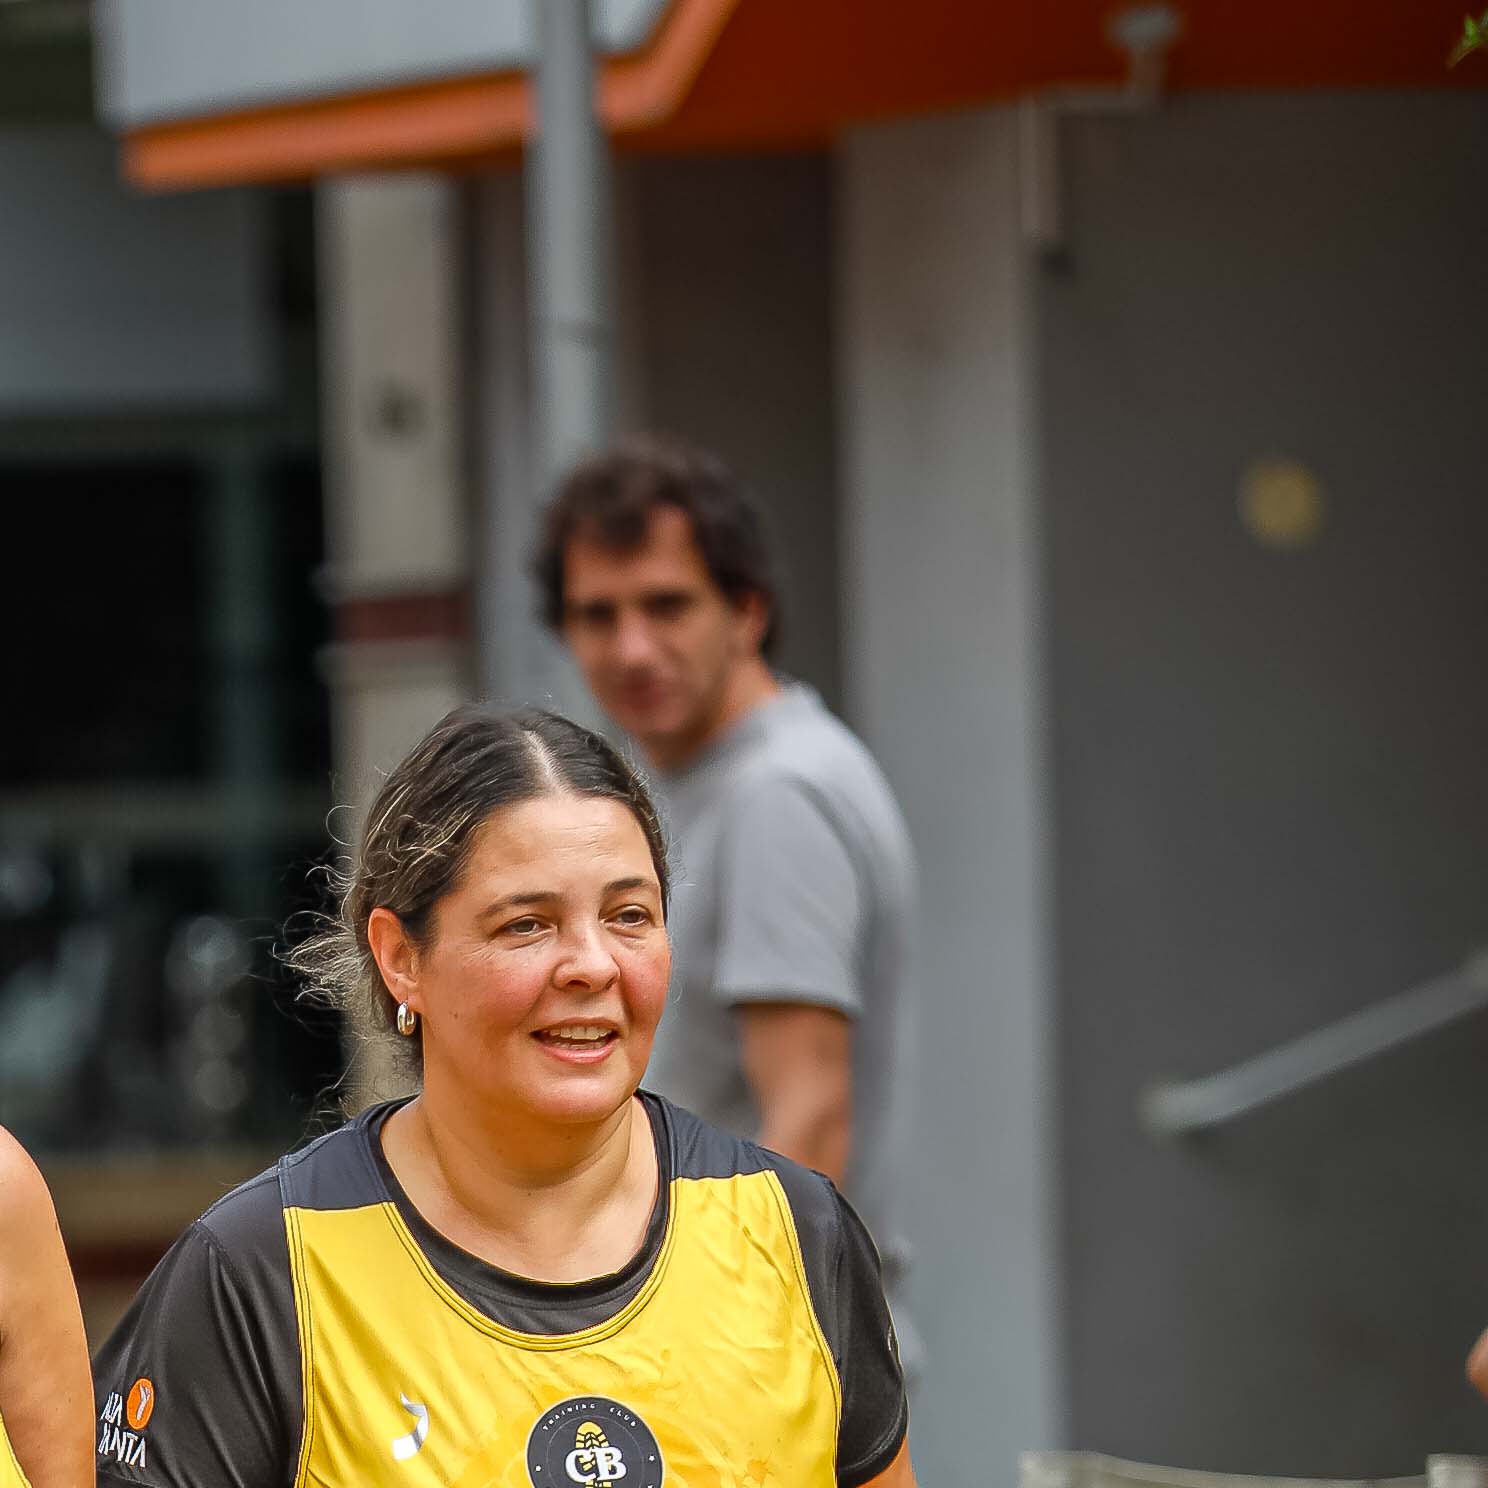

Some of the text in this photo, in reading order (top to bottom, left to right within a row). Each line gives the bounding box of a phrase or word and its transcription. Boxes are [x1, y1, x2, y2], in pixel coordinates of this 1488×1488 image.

[542, 1403, 637, 1431] TRAINING CLUB
[565, 1445, 627, 1483] CB
